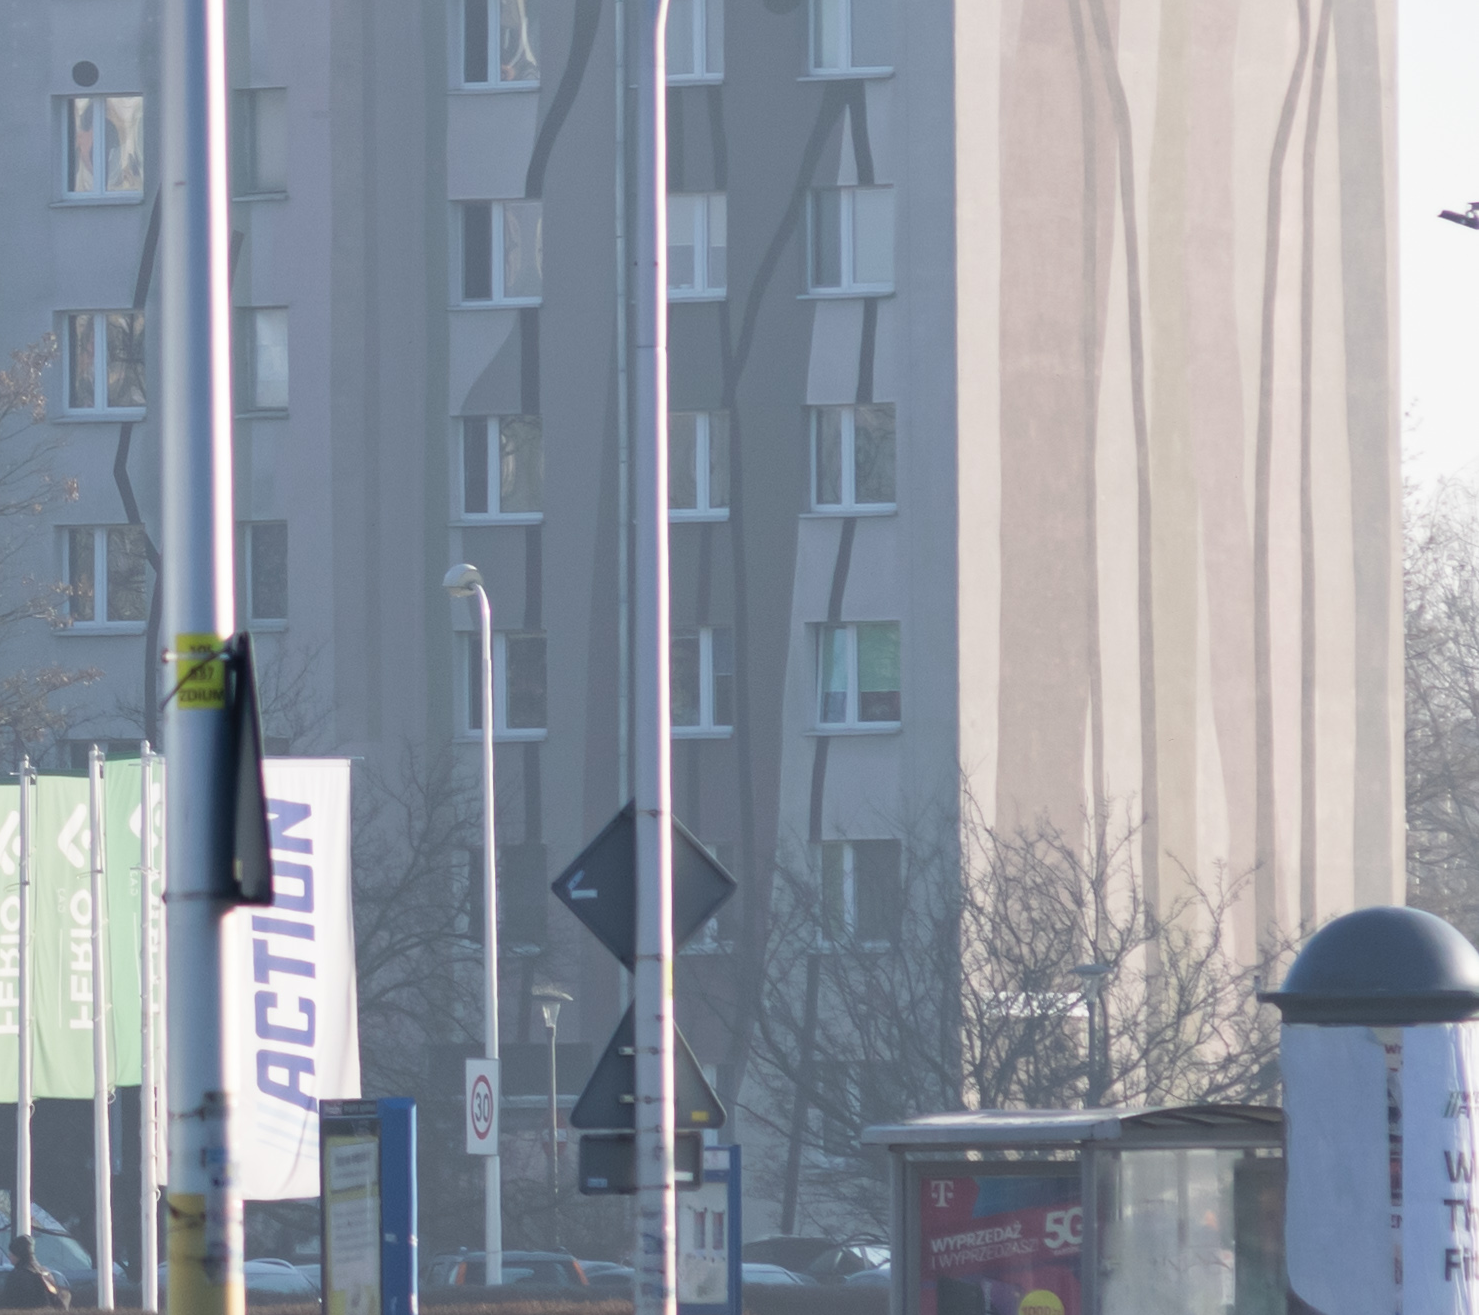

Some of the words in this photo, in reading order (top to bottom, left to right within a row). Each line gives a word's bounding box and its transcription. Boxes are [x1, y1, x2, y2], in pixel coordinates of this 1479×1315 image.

[252, 797, 317, 1114] ACTION
[475, 1092, 490, 1123] 30
[930, 1220, 1023, 1253] WYPRZEDAŻ
[1043, 1206, 1083, 1249] 5G
